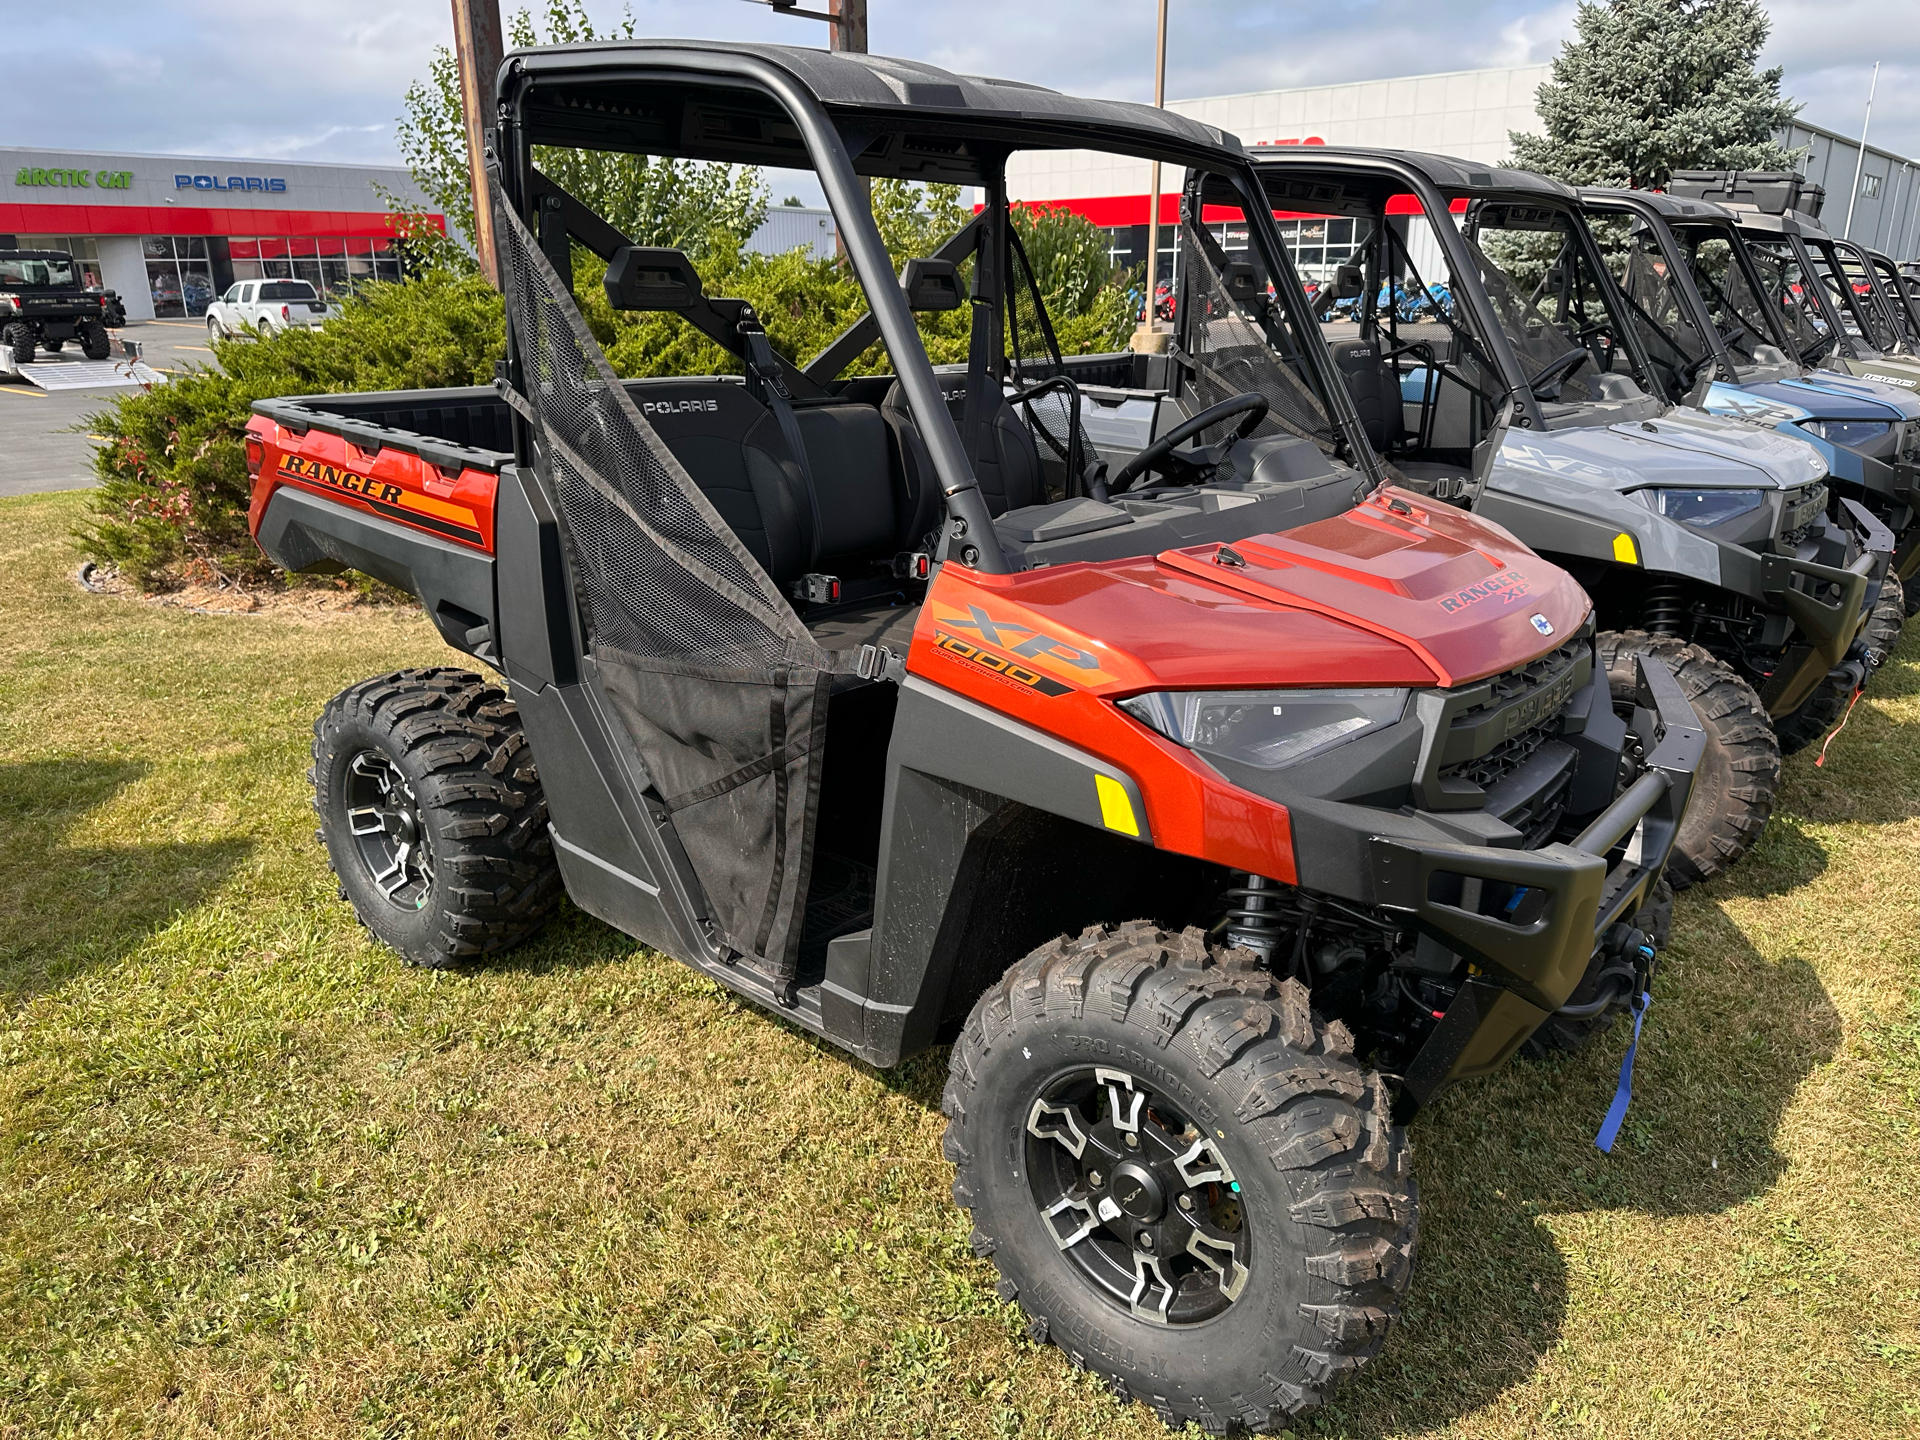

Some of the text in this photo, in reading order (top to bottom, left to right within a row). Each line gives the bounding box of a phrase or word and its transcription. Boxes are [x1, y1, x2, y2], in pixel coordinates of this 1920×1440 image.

[15, 167, 135, 190] ARCTIC CAT
[174, 174, 288, 193] POLARIS
[1350, 349, 1371, 359] POLARIS
[643, 399, 719, 414] POLARIS
[285, 455, 404, 504] RANGER
[1438, 570, 1528, 614] RANGER
[1502, 582, 1532, 605] XP
[931, 632, 1042, 686] 1000
[937, 603, 1101, 670] XP
[930, 647, 1034, 696] DUAL OVERHEAD CAM
[1504, 671, 1573, 737] POLARIS
[1065, 1034, 1197, 1104] PRO ARMOR
[1032, 1279, 1169, 1382] X-TERRAIN
